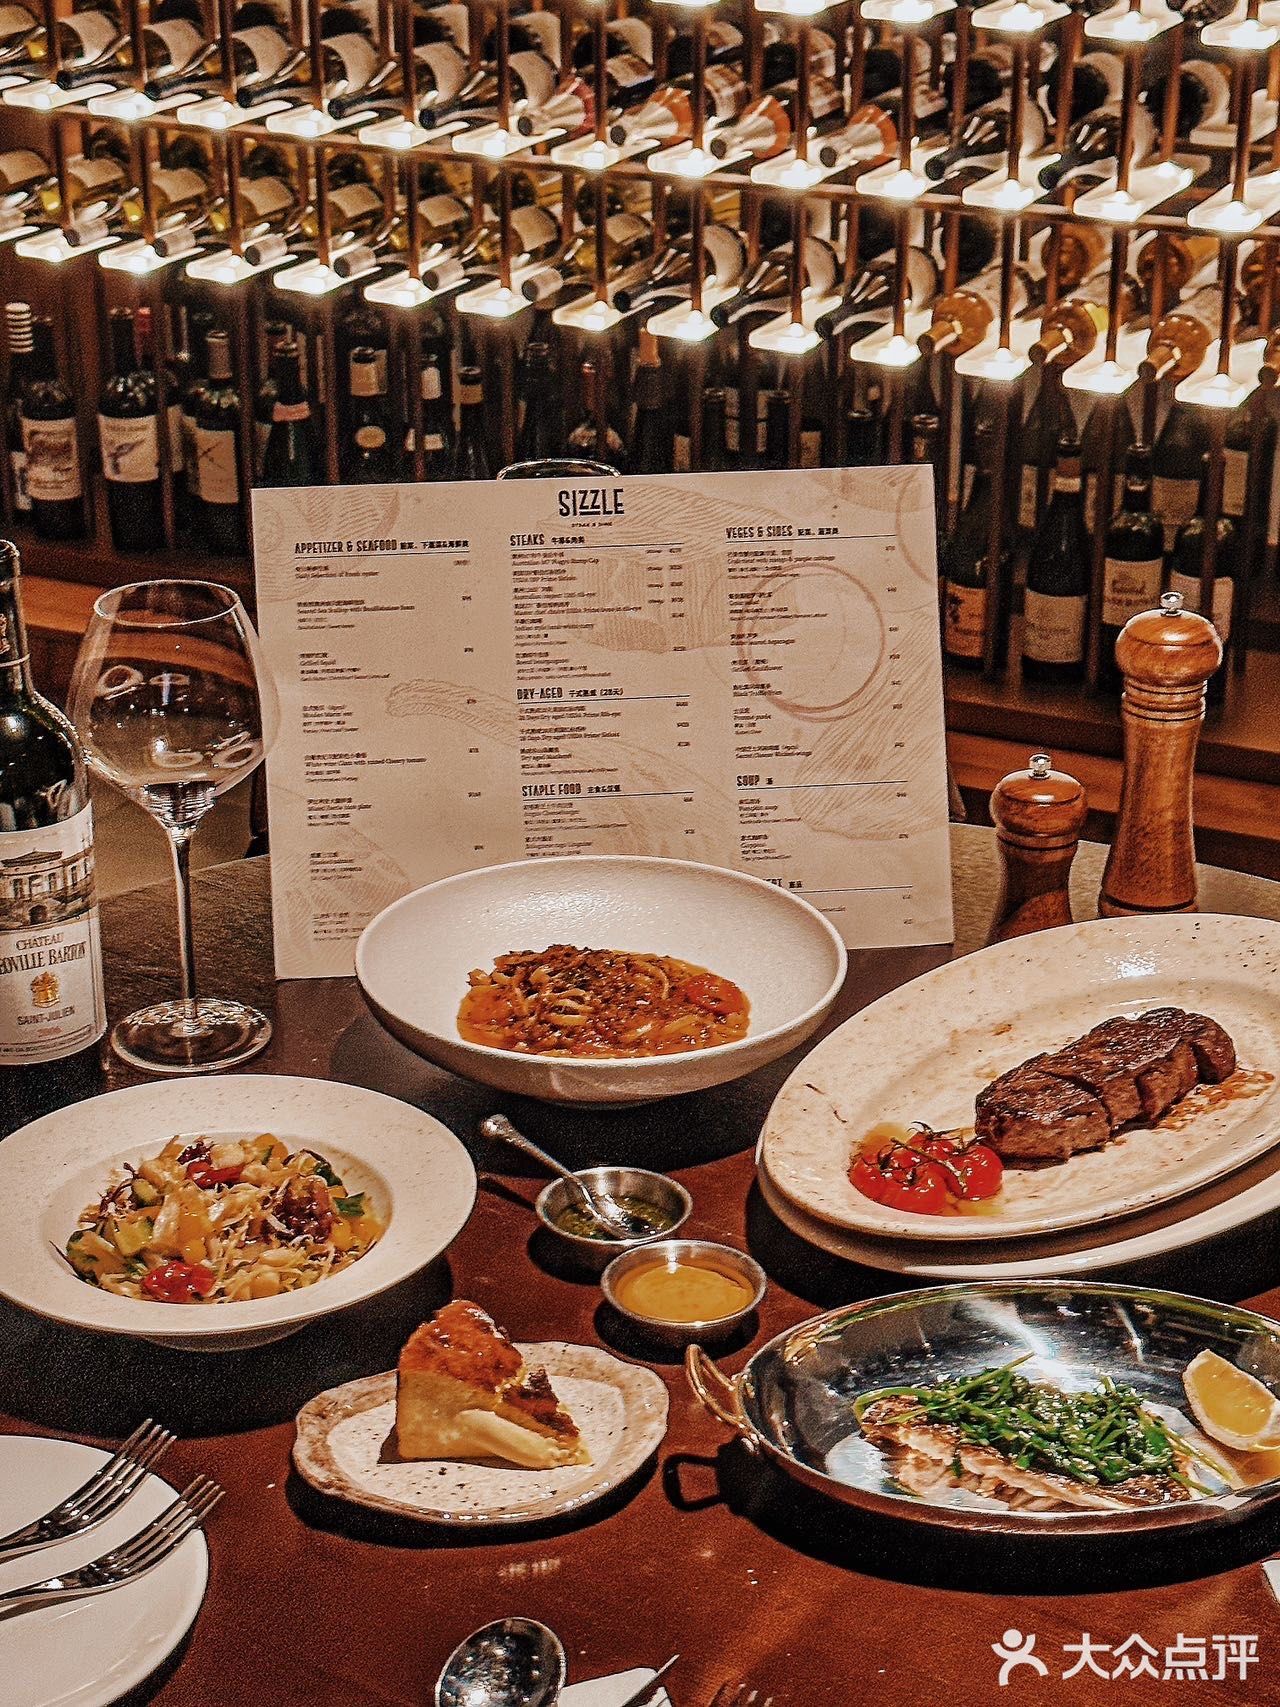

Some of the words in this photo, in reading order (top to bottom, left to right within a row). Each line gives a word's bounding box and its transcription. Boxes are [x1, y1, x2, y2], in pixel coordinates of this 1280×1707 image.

[558, 488, 625, 517] SIZZLE
[726, 526, 754, 539] VEGES
[766, 525, 793, 537] SIDES
[295, 540, 343, 554] APPETIZER
[347, 540, 353, 552] &
[356, 539, 397, 552] SEAFOOD
[510, 533, 545, 546] STEAKS
[517, 687, 563, 700] DRY-AGED
[736, 775, 759, 787] SOUP
[522, 784, 555, 797] STAPLE
[558, 783, 582, 795] FOOD
